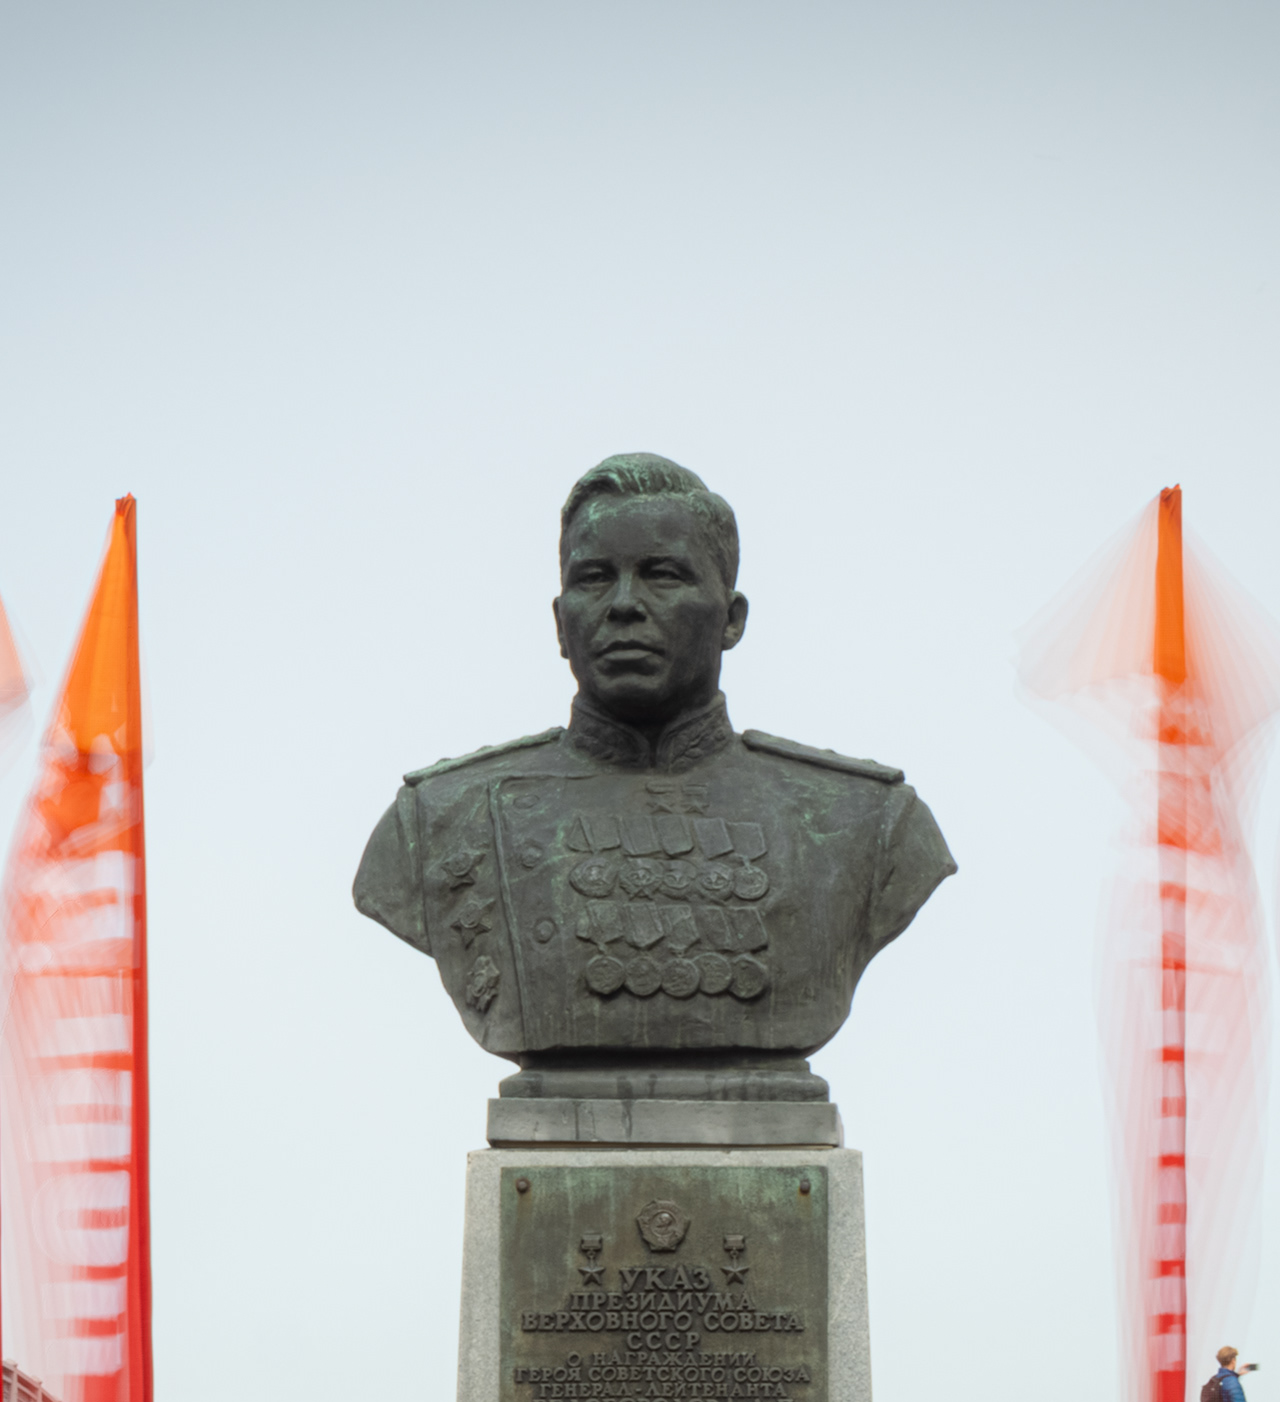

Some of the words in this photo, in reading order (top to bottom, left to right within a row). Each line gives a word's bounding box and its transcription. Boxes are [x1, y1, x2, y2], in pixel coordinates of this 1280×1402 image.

[621, 1267, 710, 1291] УКАЗ
[571, 1294, 755, 1313] ПРЕЗИДИУМА
[522, 1313, 693, 1331] ВЕРХОВНОГО
[704, 1313, 803, 1331] СОВЕТА
[627, 1333, 700, 1350] СССР
[568, 1353, 581, 1367] О
[594, 1353, 755, 1367] НАГРАЖДЕНИИ
[515, 1368, 580, 1382] ГЕРОЯ
[588, 1368, 728, 1382] СОВЕТСКОГО
[735, 1368, 810, 1382] СОЮЗА
